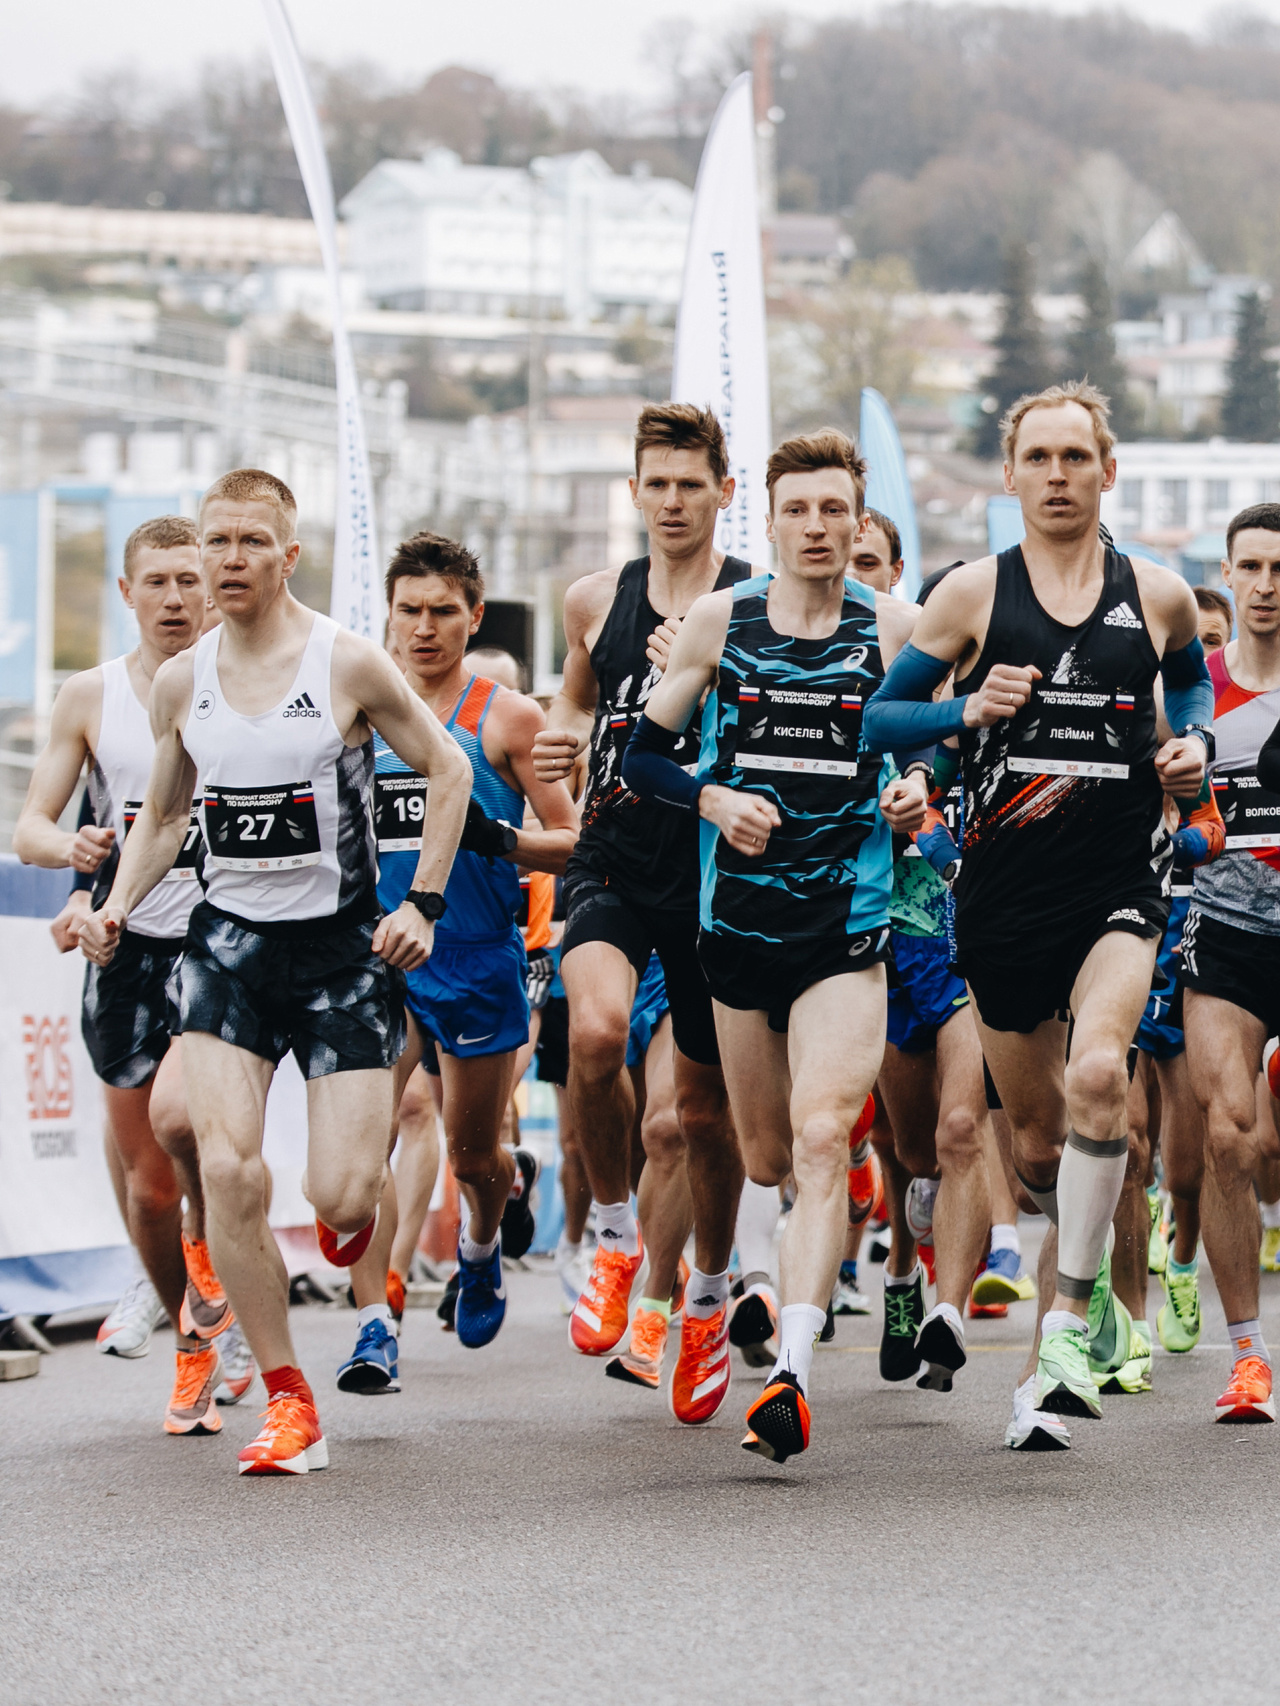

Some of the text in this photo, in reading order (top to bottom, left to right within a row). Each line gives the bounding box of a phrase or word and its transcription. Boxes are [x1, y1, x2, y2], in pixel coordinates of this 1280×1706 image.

[738, 467, 749, 556] ТИКИ
[1104, 616, 1142, 629] adidas
[765, 689, 808, 698] ЧЕМПИОНАТ
[1037, 690, 1111, 701] ЧЕМПИОНАТ РОССИИ
[784, 697, 831, 706] МАРАФОНУ
[1057, 698, 1106, 707] МАРАФОНУ
[282, 708, 321, 718] adidas
[773, 726, 823, 739] КИСЕЛЕВ
[1049, 727, 1095, 741] ЛЕЙМАН
[259, 792, 287, 800] РОССИИ
[237, 799, 283, 807] МАРАФОНУ
[393, 796, 425, 822] 19
[944, 804, 962, 828] 1
[237, 814, 275, 840] 27
[1107, 911, 1146, 925] adidas
